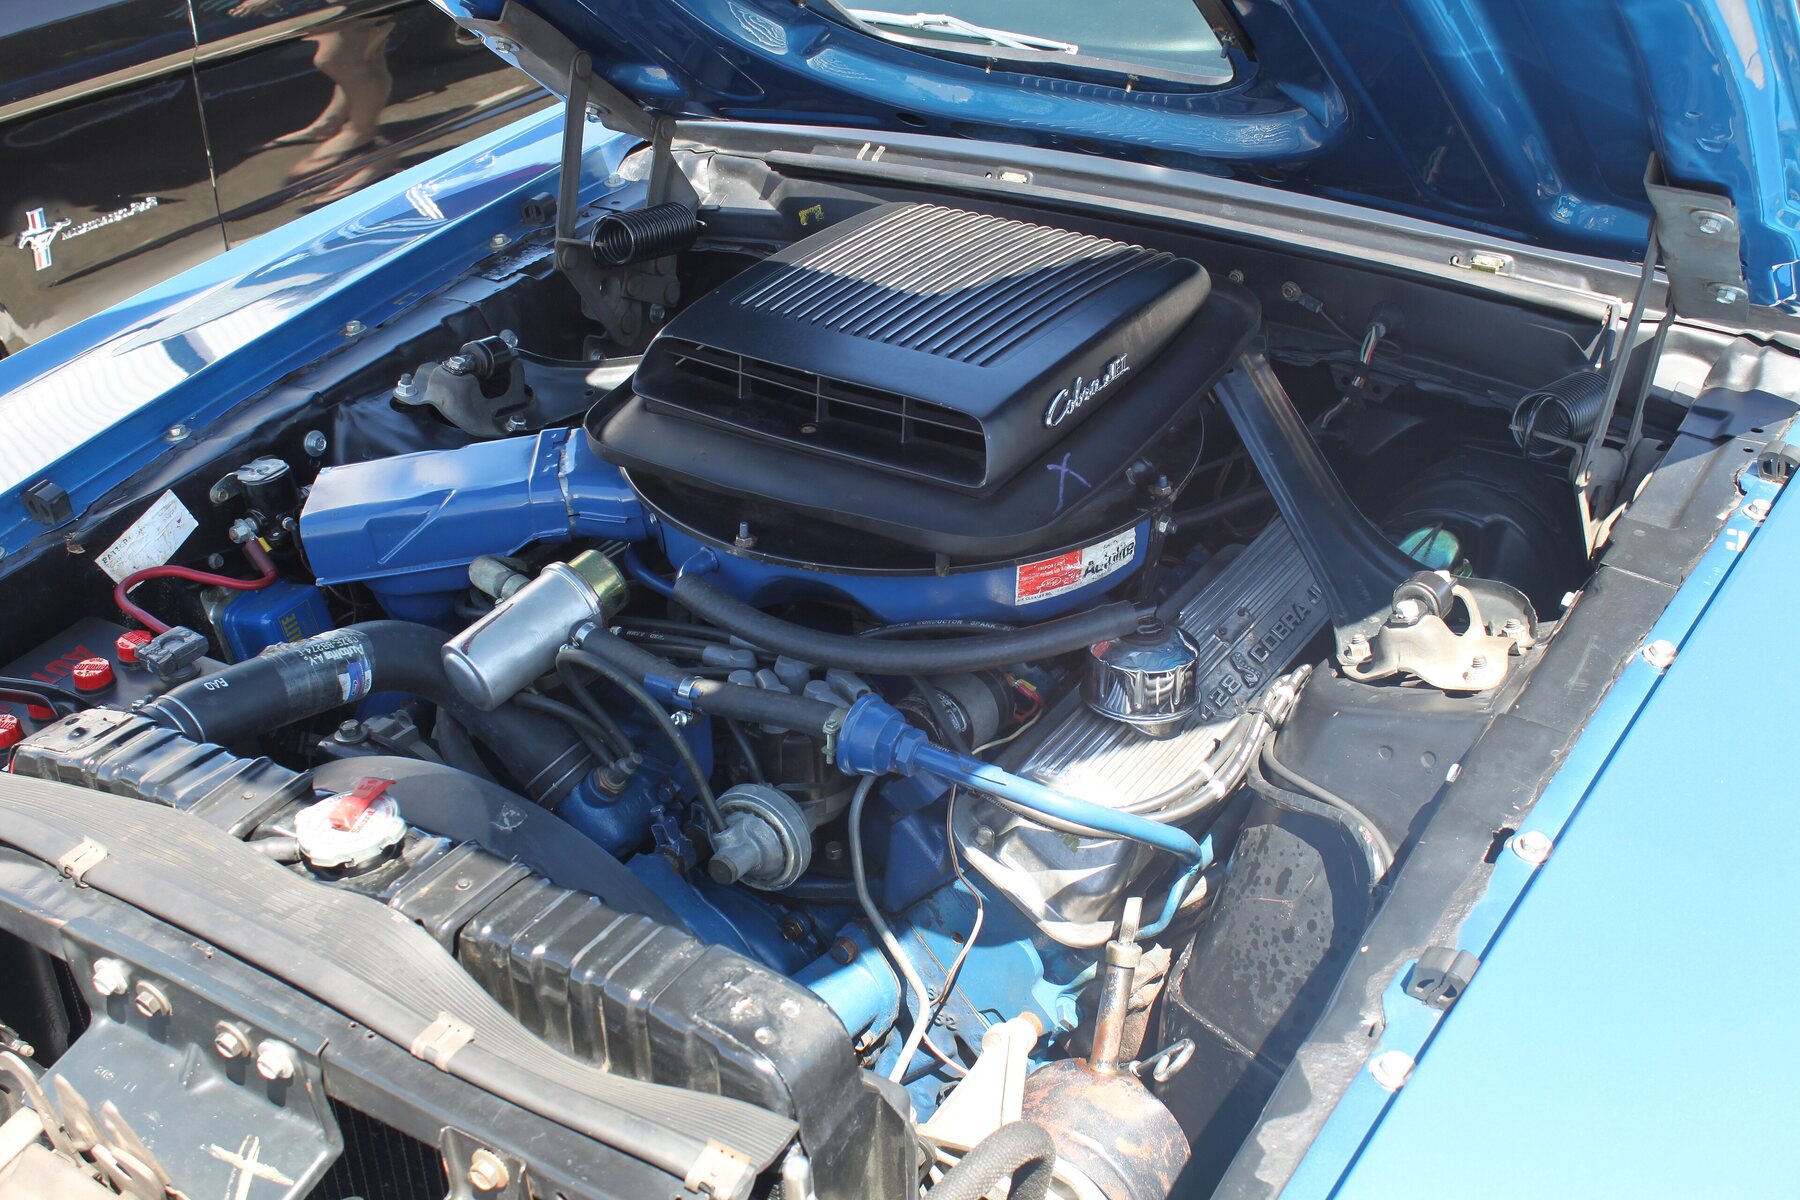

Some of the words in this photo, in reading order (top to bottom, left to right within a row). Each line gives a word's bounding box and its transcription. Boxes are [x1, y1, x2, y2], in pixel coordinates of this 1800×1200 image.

[1045, 376, 1100, 427] Cobra
[1248, 603, 1312, 663] COBRA
[203, 677, 229, 691] RAD
